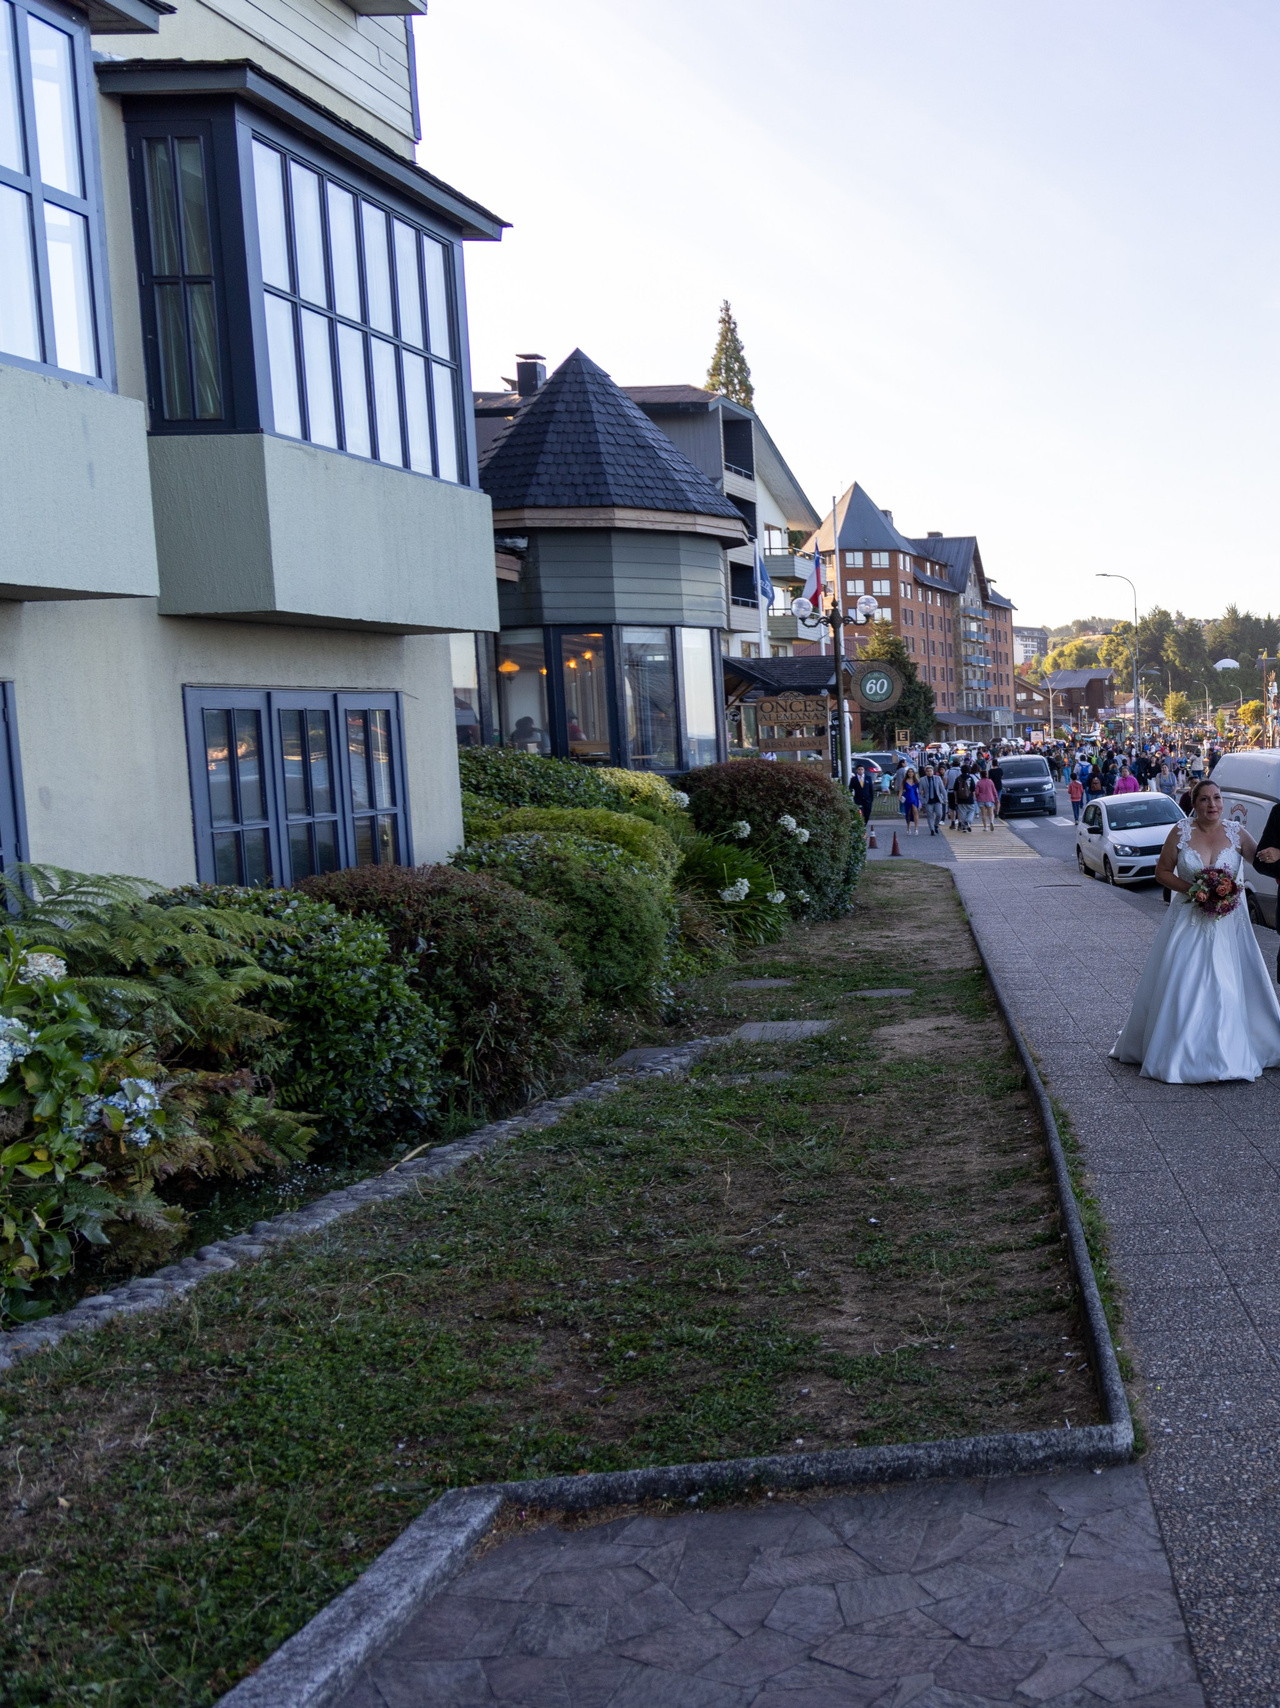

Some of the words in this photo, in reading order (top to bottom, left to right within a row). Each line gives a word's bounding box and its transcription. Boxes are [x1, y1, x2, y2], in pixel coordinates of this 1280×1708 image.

[866, 678, 888, 695] 60
[760, 700, 826, 714] ONCES
[759, 713, 827, 722] ALEMANAS
